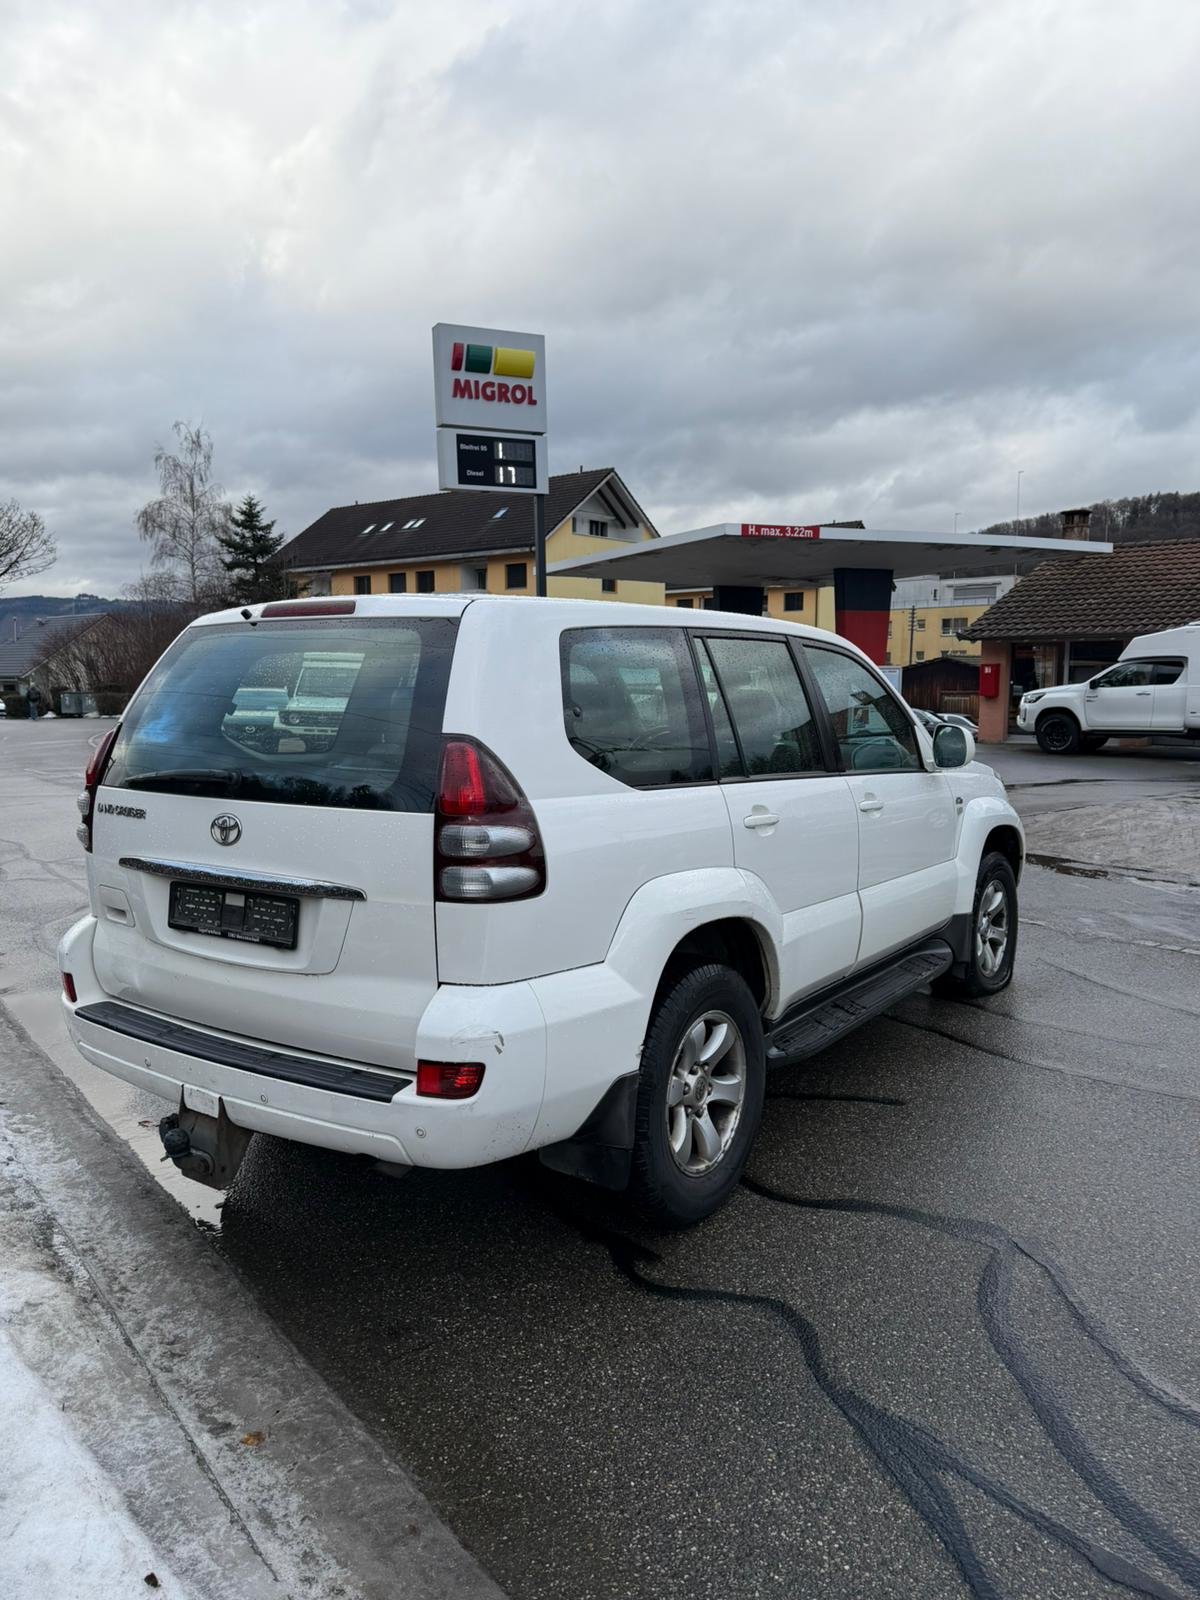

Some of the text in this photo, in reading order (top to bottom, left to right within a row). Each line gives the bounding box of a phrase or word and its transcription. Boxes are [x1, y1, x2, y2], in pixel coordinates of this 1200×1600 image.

[452, 378, 537, 405] MIGROL
[748, 525, 814, 538] H. max. 3.22m
